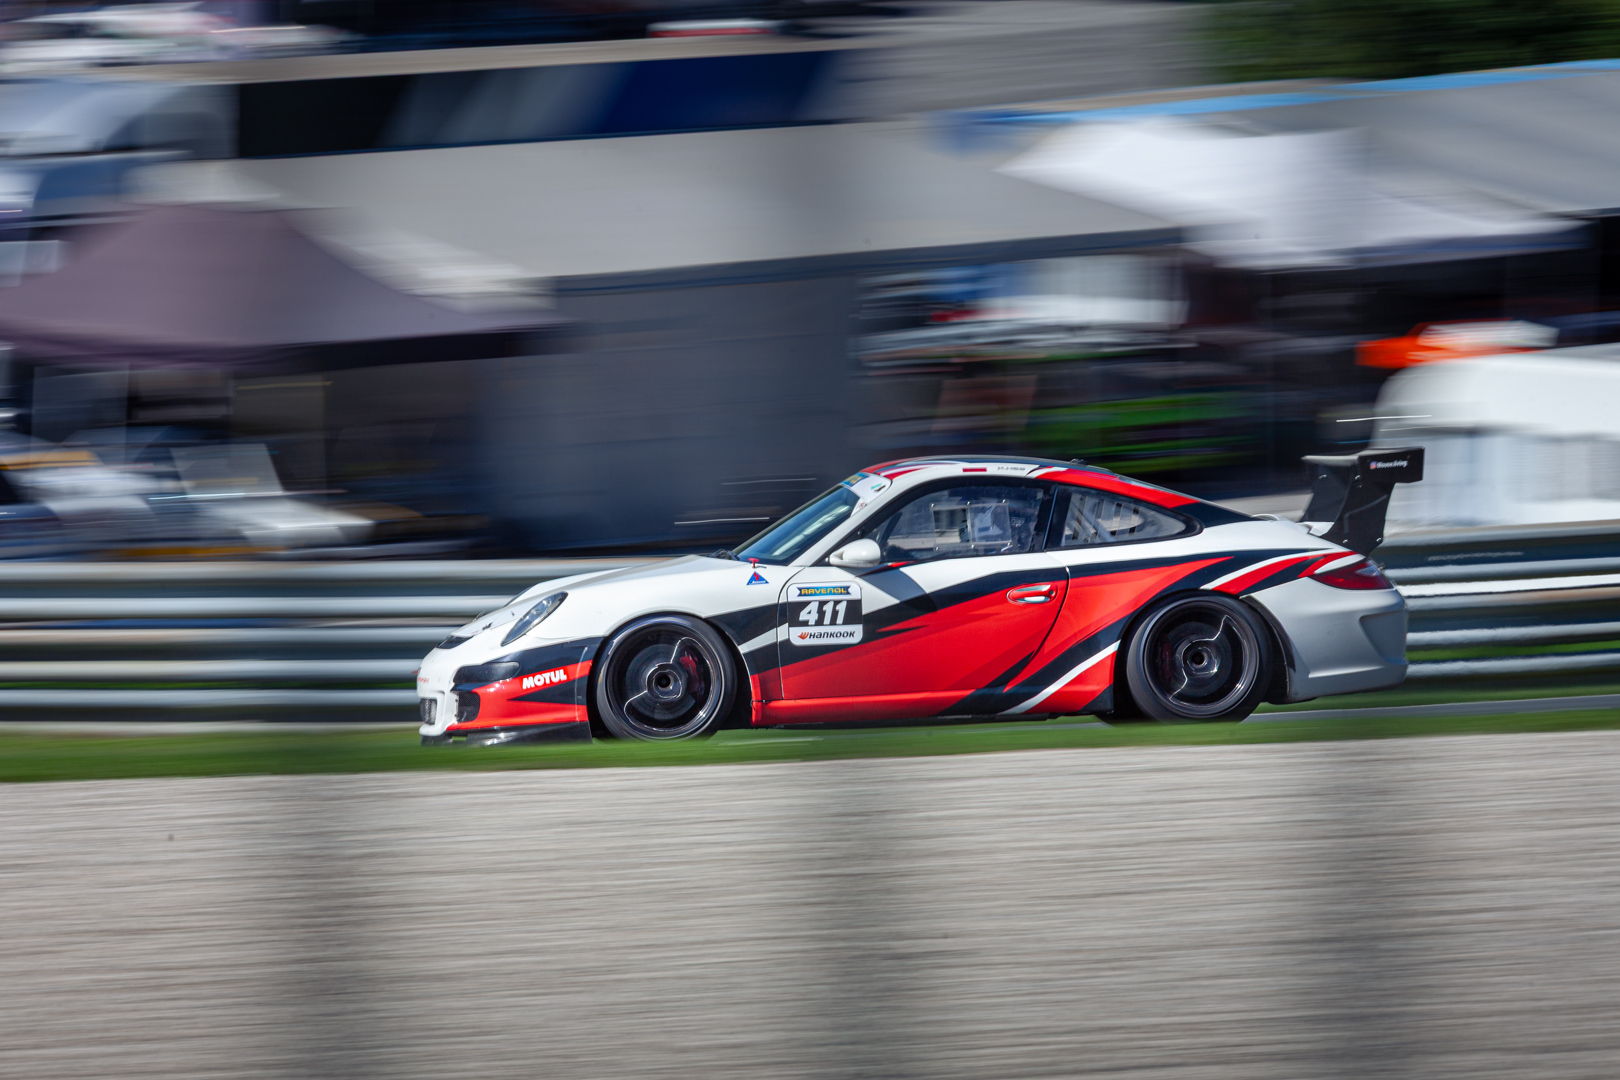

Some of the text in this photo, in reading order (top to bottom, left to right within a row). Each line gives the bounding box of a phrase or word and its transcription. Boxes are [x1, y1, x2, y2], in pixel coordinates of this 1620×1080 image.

[801, 587, 848, 595] RAVENOL
[799, 600, 847, 626] 411
[522, 669, 567, 690] MOTUL
